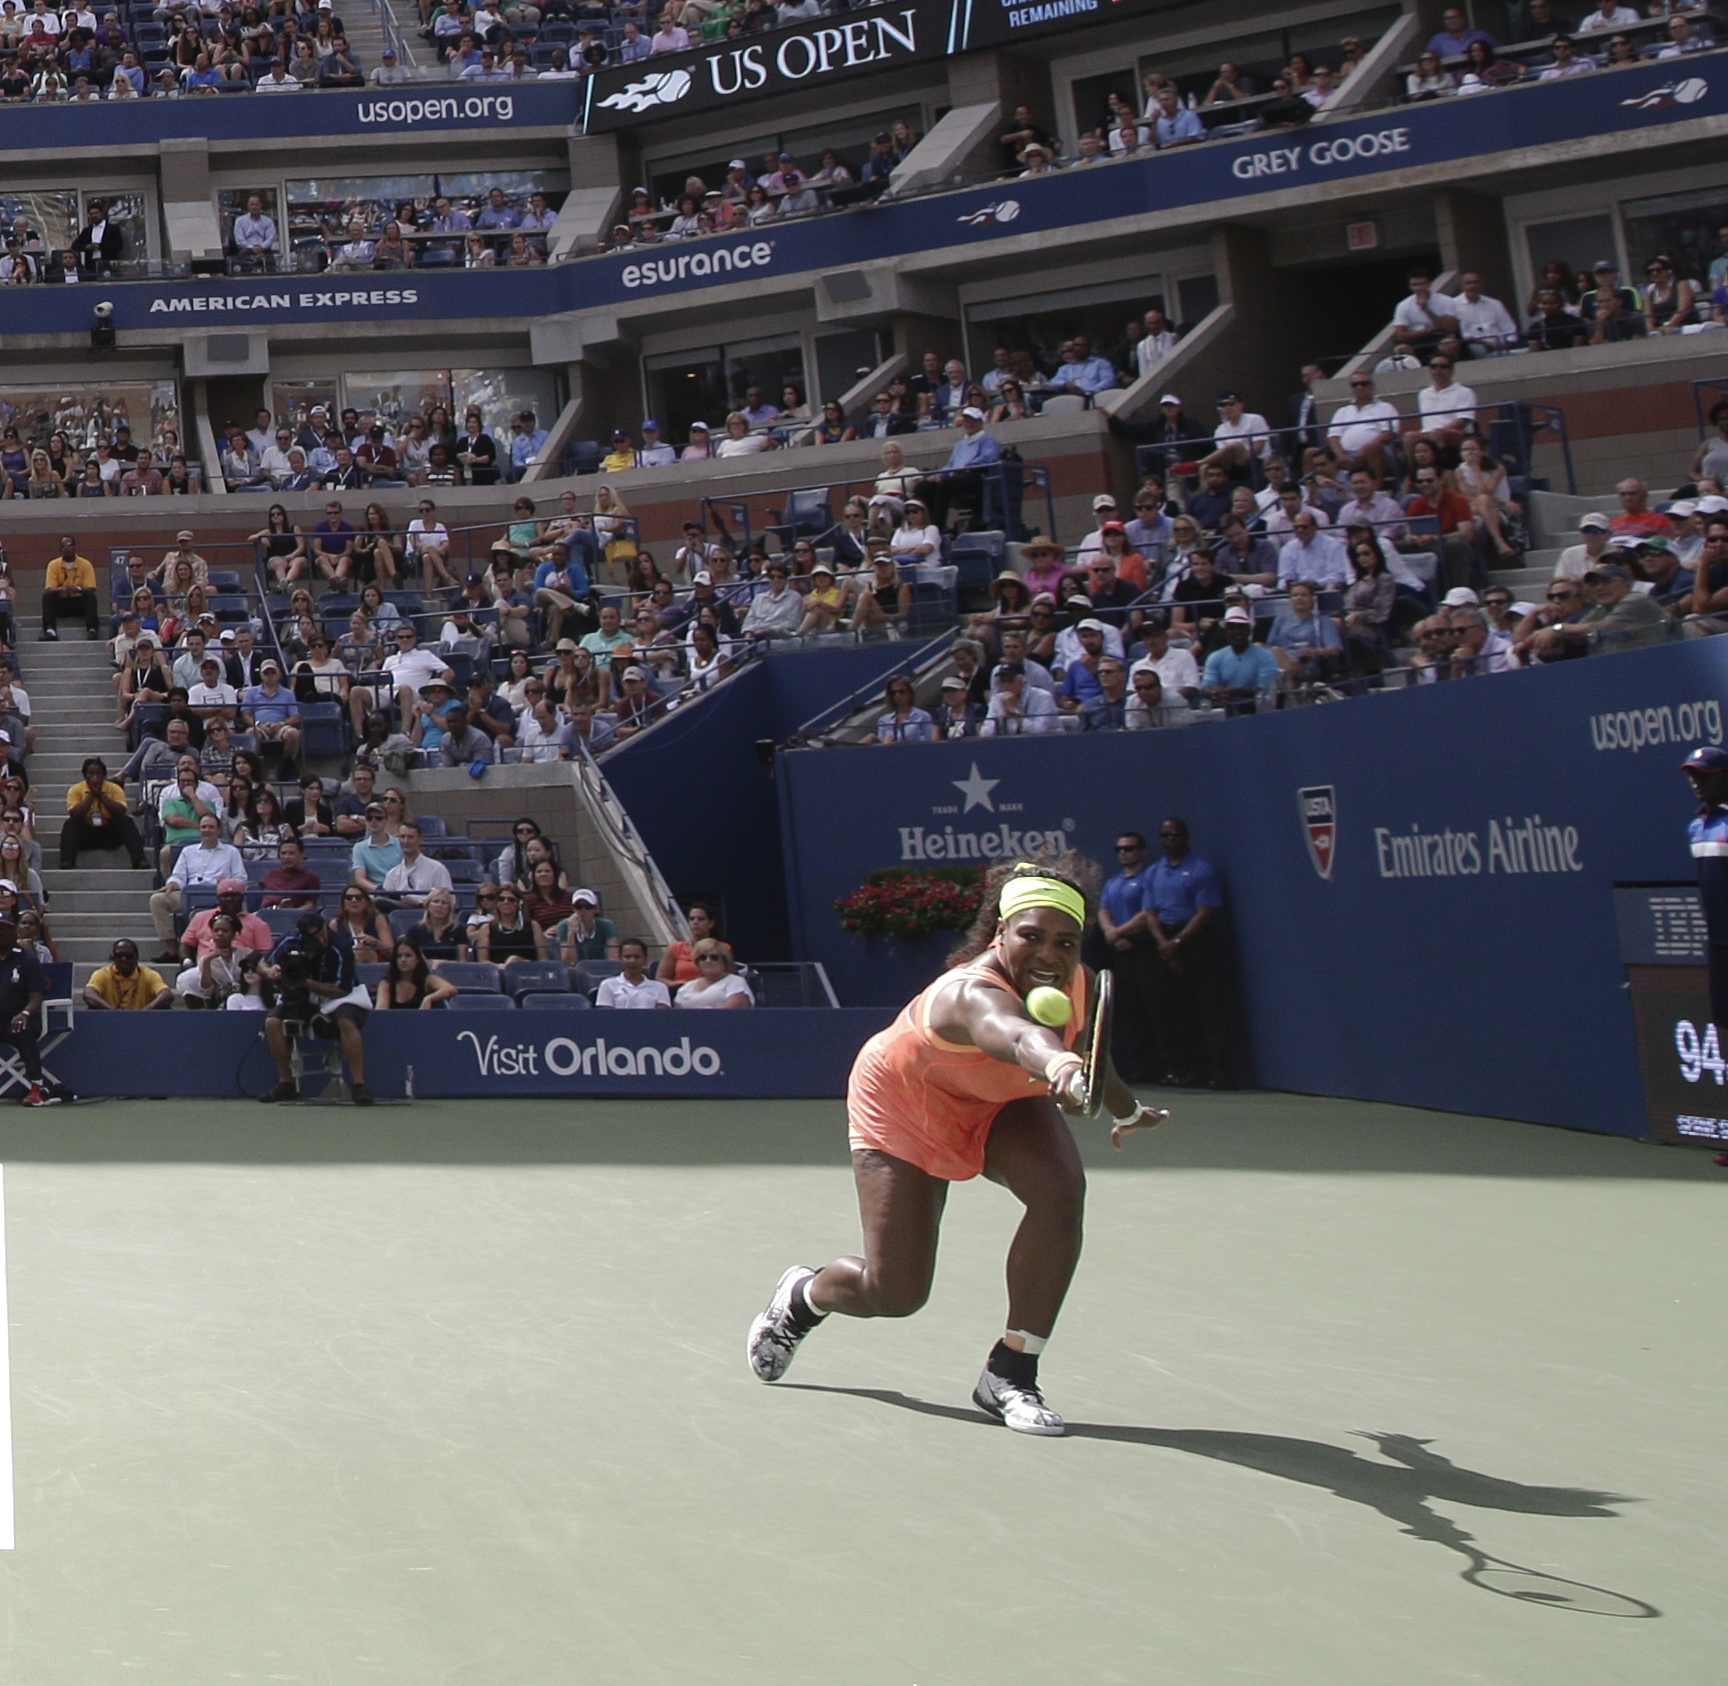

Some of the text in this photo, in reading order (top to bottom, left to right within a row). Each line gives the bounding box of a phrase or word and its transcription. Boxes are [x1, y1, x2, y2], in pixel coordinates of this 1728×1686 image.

[705, 9, 917, 96] US OPEN
[357, 91, 513, 124] usopen.org
[1231, 127, 1410, 181] GREY GOOSE
[622, 241, 771, 288] esurance
[149, 289, 418, 313] AMERICAN EXPRESS
[1590, 700, 1723, 751] usopen.org
[898, 824, 1066, 860] Heineken
[1375, 816, 1583, 878] Emirates Airline
[457, 1030, 721, 1076] Visit Orlando
